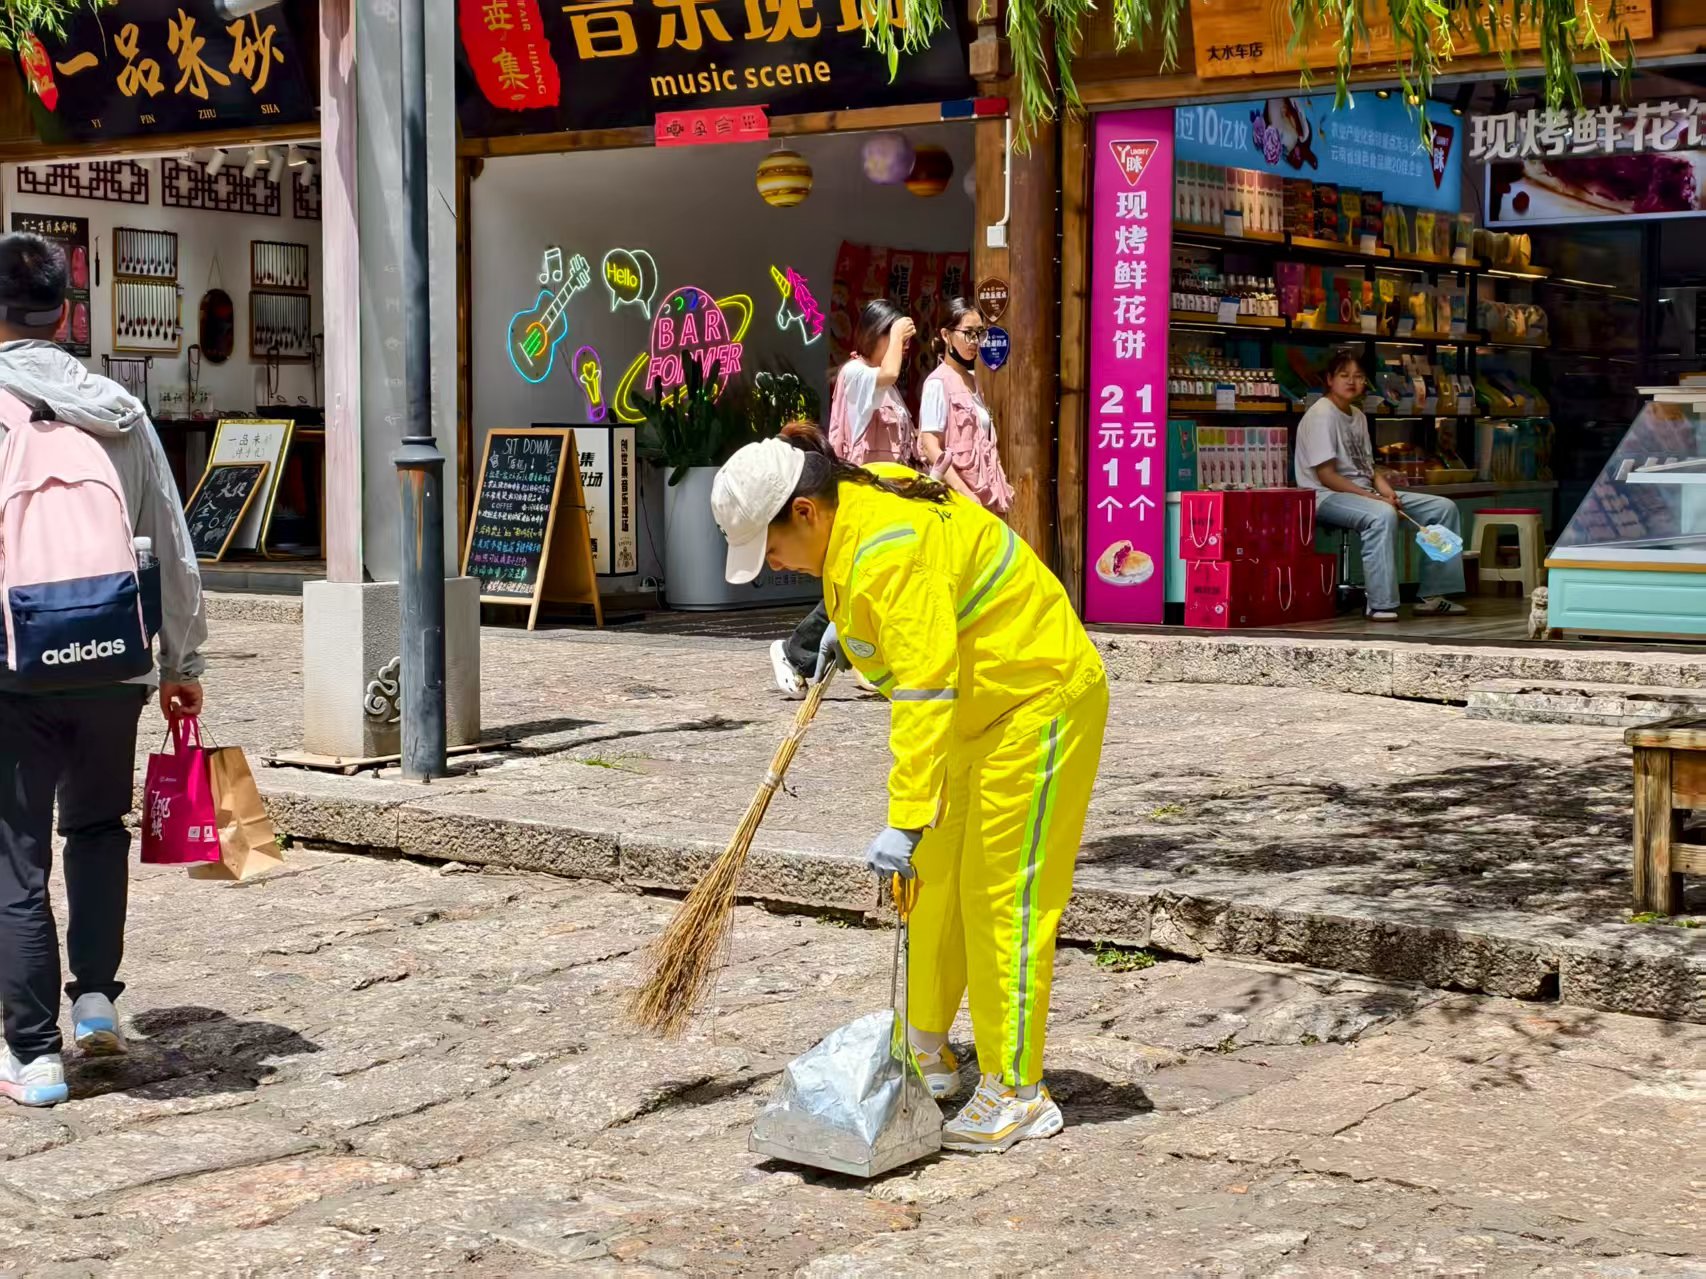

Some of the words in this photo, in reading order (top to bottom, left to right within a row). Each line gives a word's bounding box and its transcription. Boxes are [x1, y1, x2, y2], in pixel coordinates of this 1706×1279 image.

[55, 8, 285, 100] 一品朱砂
[1207, 42, 1264, 60] 大水车店
[650, 63, 737, 96] music
[746, 60, 832, 89] scene
[90, 119, 101, 128] YI
[140, 114, 156, 124] PIN
[198, 109, 217, 119] ZHU
[260, 104, 281, 114] SHA
[1175, 106, 1248, 152] 过10亿枚
[606, 261, 638, 288] Hello
[1112, 191, 1149, 360] 现烤鲜花饼
[657, 309, 721, 349] BAR
[503, 438, 519, 455] SIT
[523, 438, 552, 455] DOWN
[578, 451, 596, 468] 集
[491, 503, 513, 511] COFFEE
[41, 637, 127, 666] adidas
